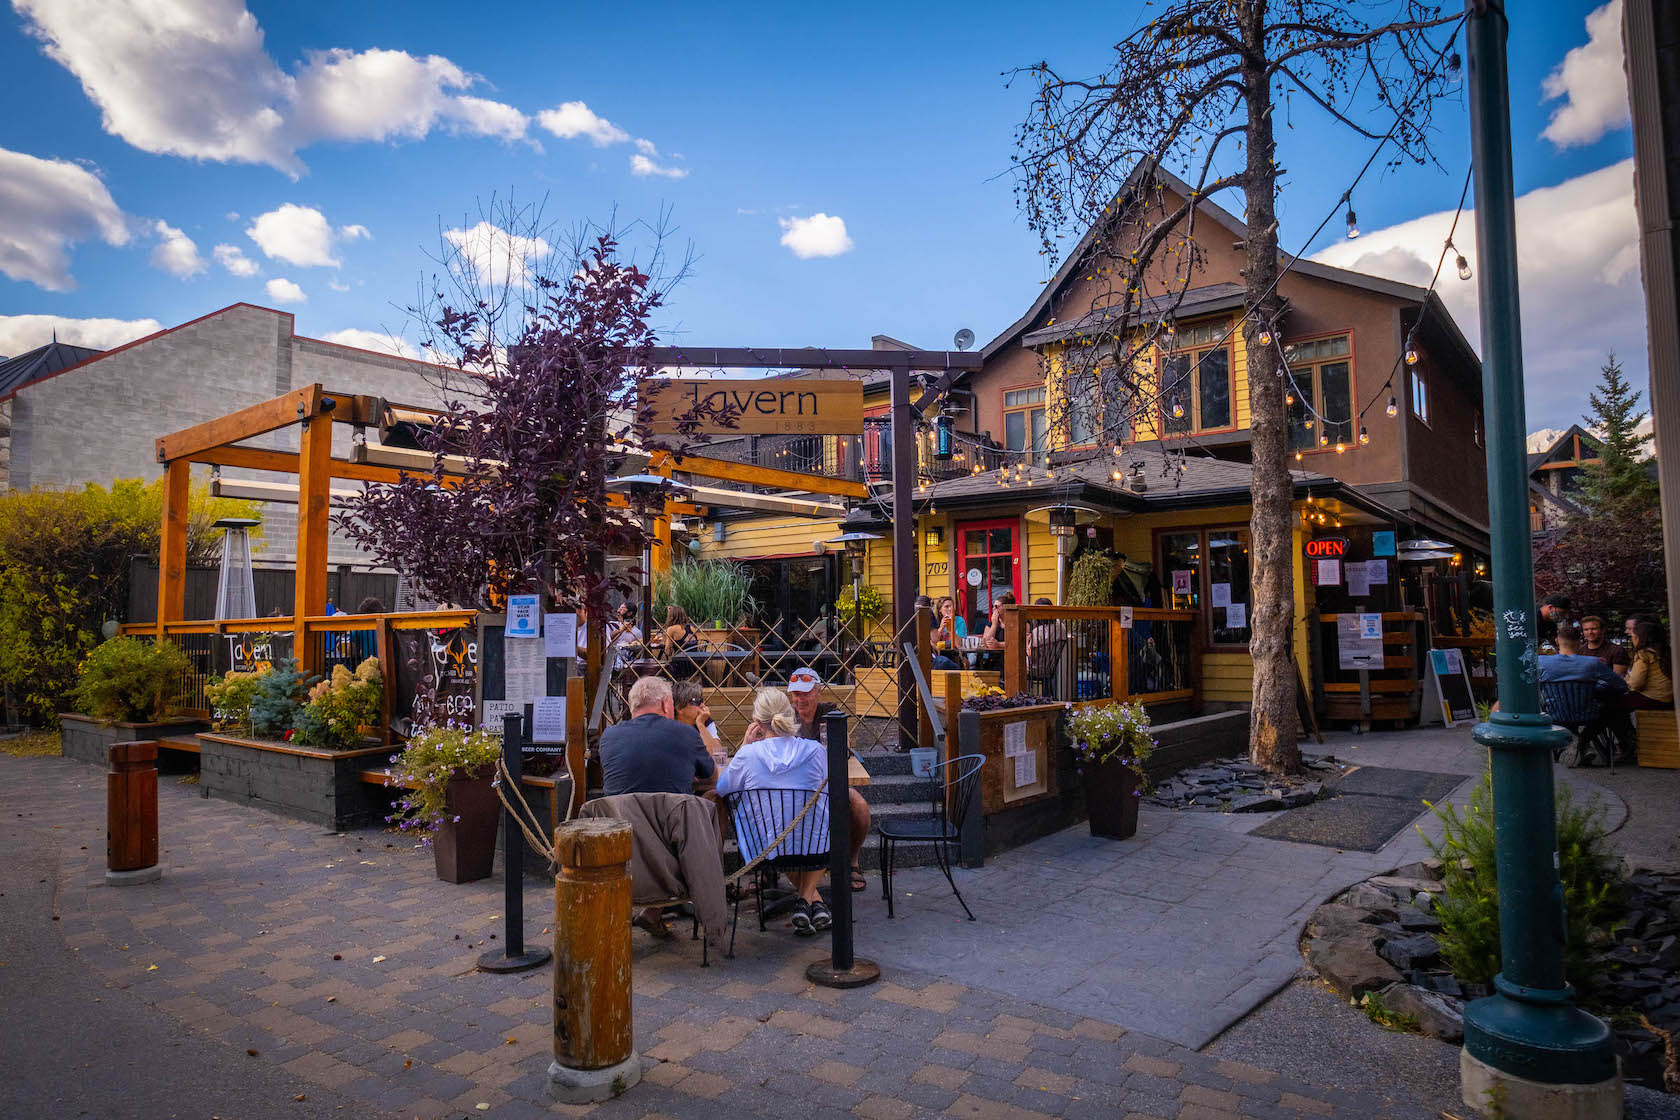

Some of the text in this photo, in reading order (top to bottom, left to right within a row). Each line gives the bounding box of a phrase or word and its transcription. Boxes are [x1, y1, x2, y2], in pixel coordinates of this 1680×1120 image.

[684, 382, 818, 420] Tavern
[775, 421, 816, 432] 1883
[1306, 541, 1343, 556] OPEN
[927, 562, 948, 575] 709
[489, 703, 515, 711] PATIO
